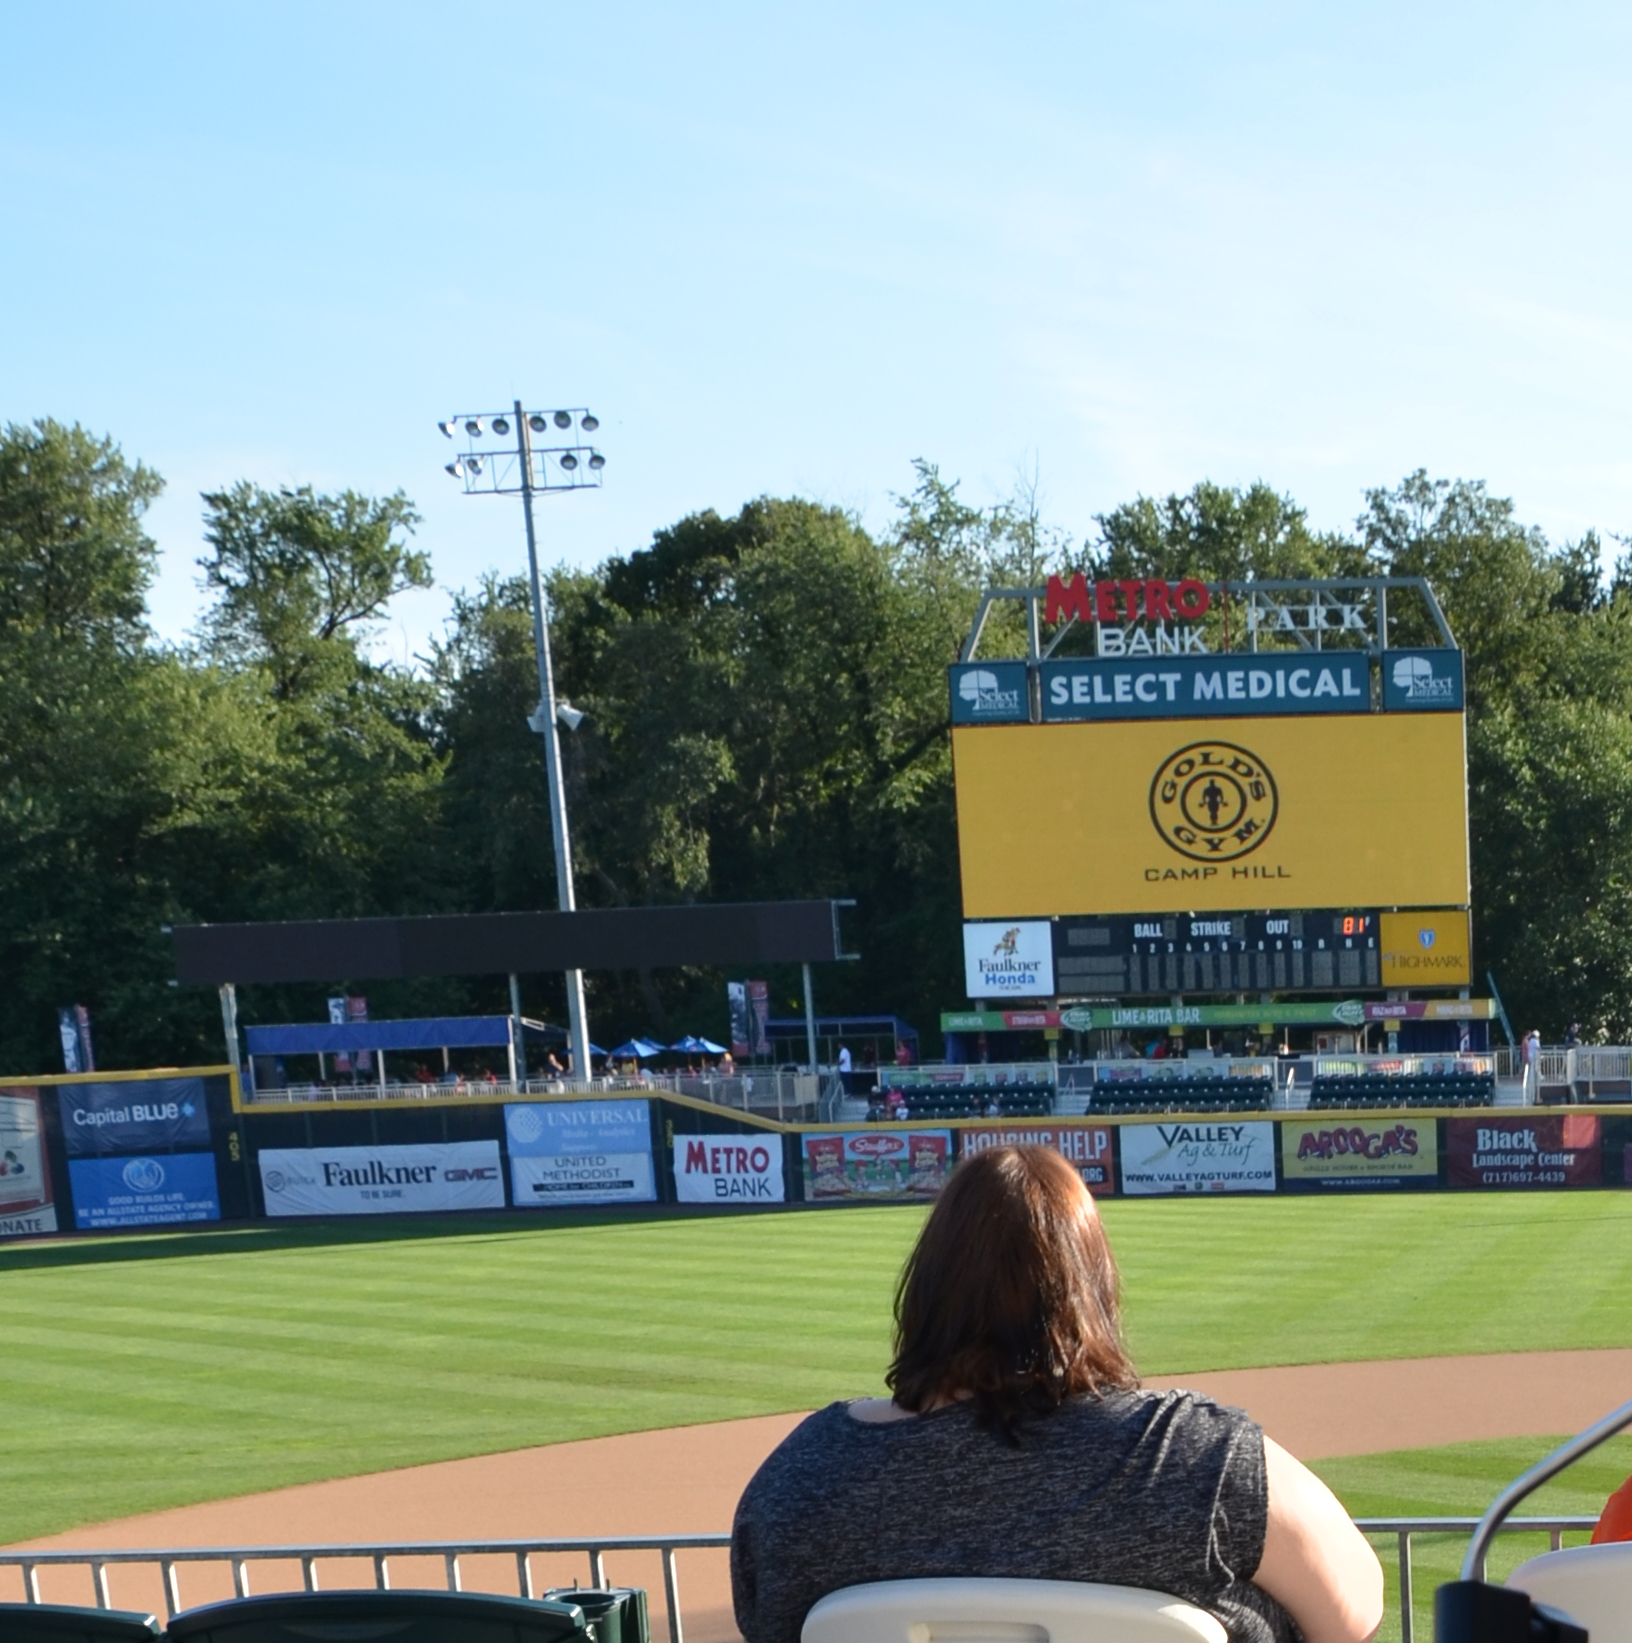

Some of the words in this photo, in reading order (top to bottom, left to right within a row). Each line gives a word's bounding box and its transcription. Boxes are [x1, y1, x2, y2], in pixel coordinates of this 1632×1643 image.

[1045, 571, 1210, 623] METRO
[1246, 604, 1368, 631] PARK
[1100, 626, 1210, 657] BANK
[1050, 673, 1181, 705] SELECT
[1193, 668, 1361, 700] MEDICAL
[1413, 675, 1453, 688] Select
[980, 689, 1018, 701] Select
[1161, 752, 1267, 804] GOLD'S
[1173, 817, 1261, 852] GYM
[1144, 867, 1218, 882] CAMP
[1231, 865, 1292, 879] HILL
[1134, 922, 1163, 938] BALL
[1190, 920, 1232, 936] STRIKE
[1266, 919, 1289, 934] OUT
[1150, 942, 1156, 953] 2
[1167, 942, 1174, 953] 3
[979, 958, 1042, 973] Faulkner
[985, 972, 1036, 985] Honda
[1176, 1007, 1200, 1023] BAR
[73, 1107, 130, 1127] Capital
[547, 1108, 647, 1126] UNIVERSAL
[1059, 1131, 1108, 1160] HELP
[1156, 1125, 1245, 1149] VALLEY
[1297, 1124, 1419, 1160] AROOGA'S
[1476, 1128, 1538, 1153] Black
[685, 1140, 770, 1174] METRO
[1178, 1143, 1199, 1166] Ag
[1202, 1142, 1216, 1157] &
[1219, 1137, 1257, 1165] Turf
[1472, 1152, 1535, 1169] Landscape
[1538, 1152, 1576, 1166] Center
[555, 1156, 607, 1168] UNITED
[322, 1160, 437, 1187] Faulkner
[443, 1167, 498, 1182] GMC
[543, 1168, 621, 1181] METHODIST
[1125, 1170, 1272, 1183] WWW.VALLEYAGTURF.COM
[1482, 1171, 1566, 1184] (717)697-4439
[714, 1178, 772, 1198] BANK
